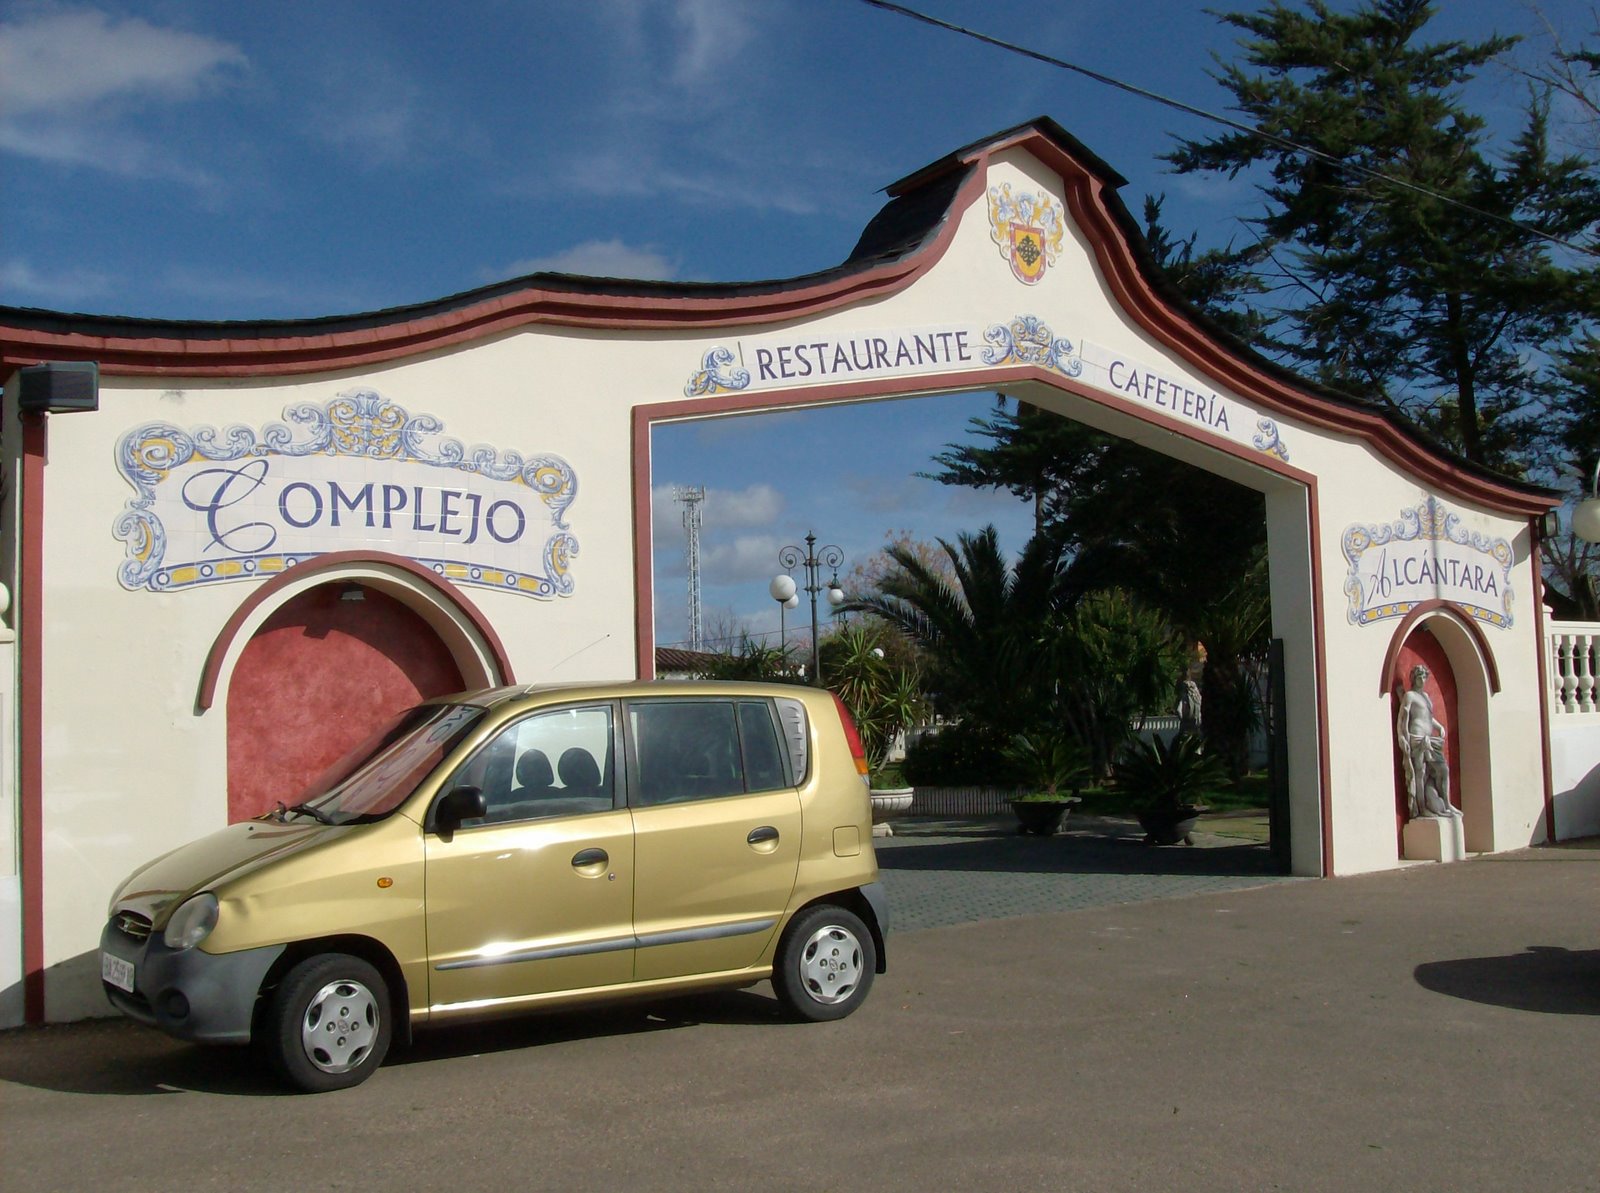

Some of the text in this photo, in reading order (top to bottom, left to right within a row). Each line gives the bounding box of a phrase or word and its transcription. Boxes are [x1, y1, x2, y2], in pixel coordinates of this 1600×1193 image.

[757, 332, 972, 380] RESTAURANTE
[1109, 361, 1230, 431] CAFETERÍA
[182, 460, 525, 553] COMPLEJO
[1368, 549, 1498, 604] ALCÁNTARA
